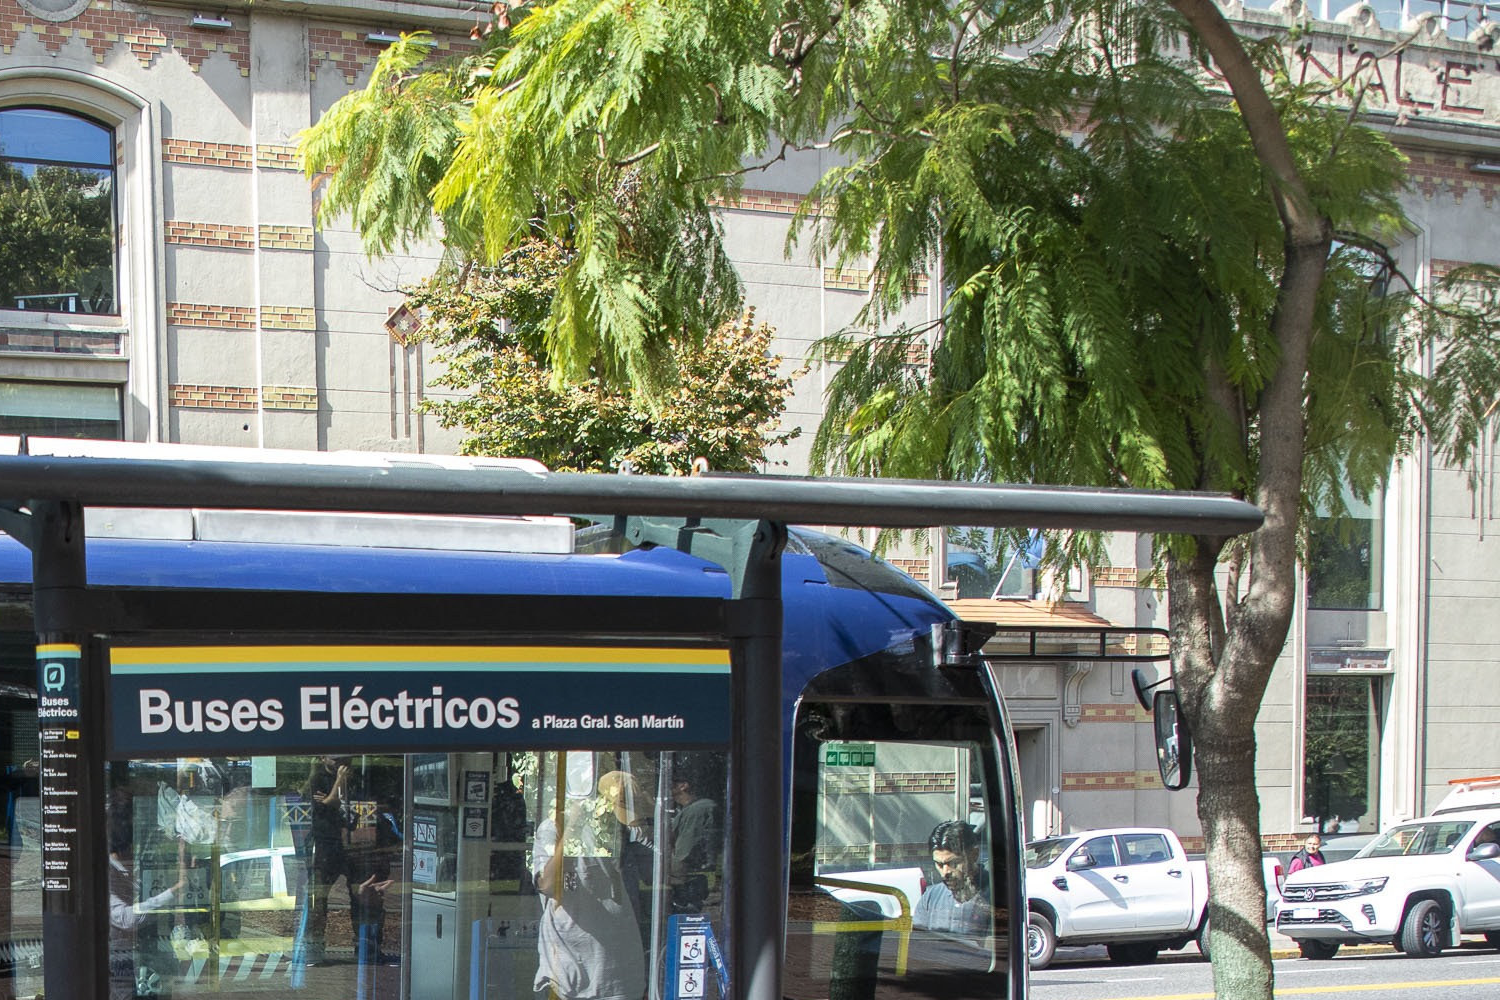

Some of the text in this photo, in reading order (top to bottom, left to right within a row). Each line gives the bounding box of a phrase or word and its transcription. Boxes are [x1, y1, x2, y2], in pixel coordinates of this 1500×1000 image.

[41, 696, 69, 706] Buses
[38, 707, 78, 718] Eléctricos
[139, 686, 684, 733] Buses Eléctricos a Plaza Gral. San Martín
